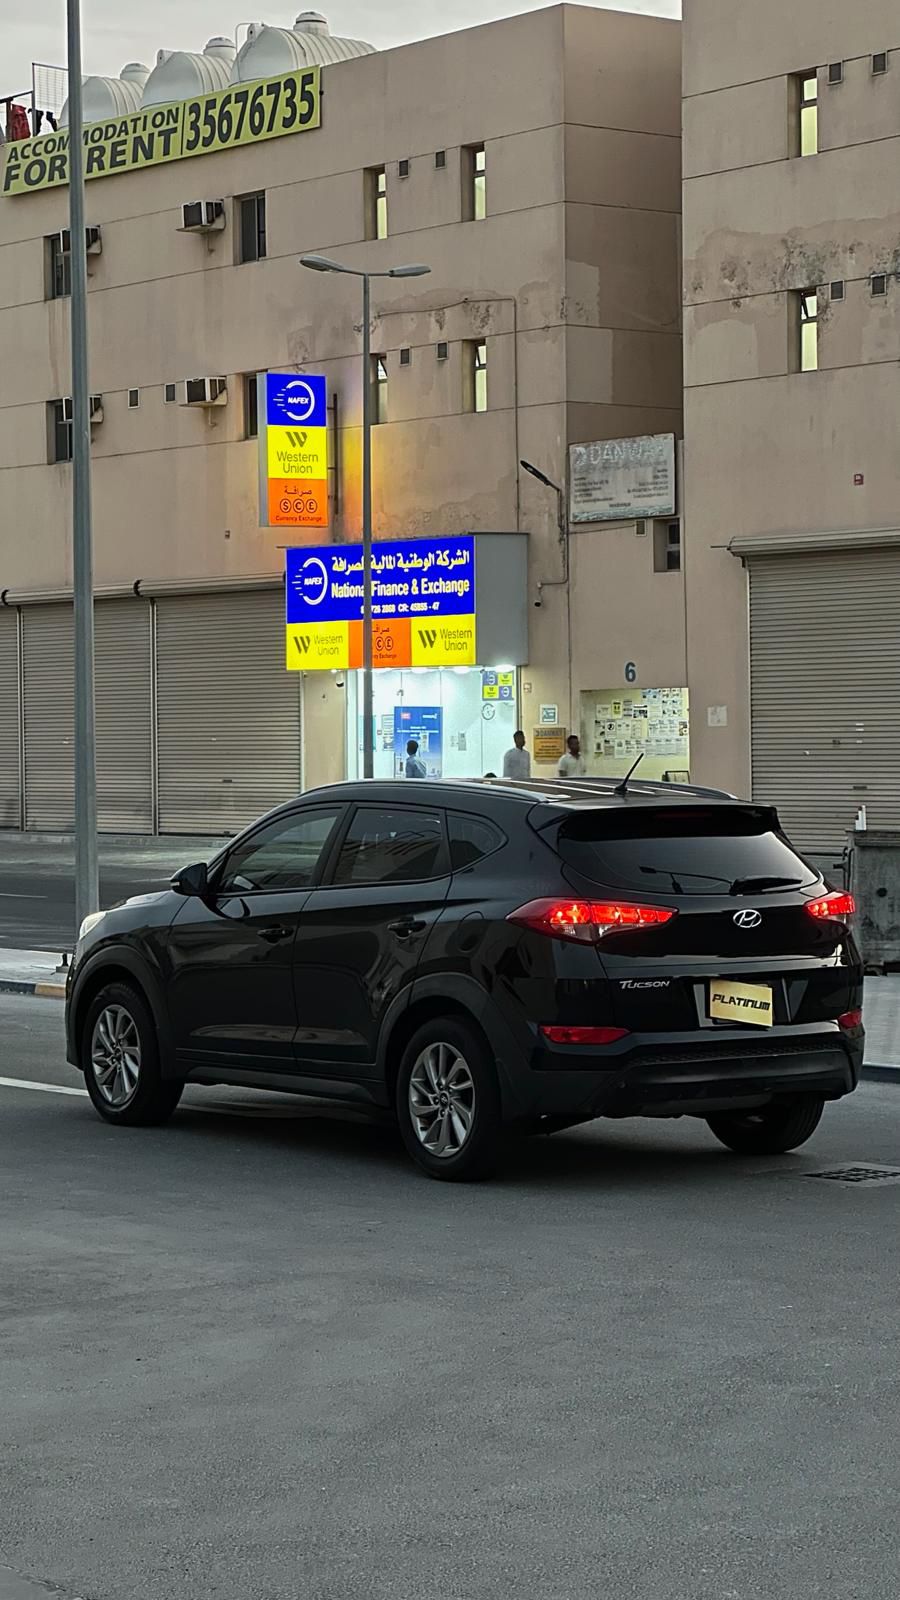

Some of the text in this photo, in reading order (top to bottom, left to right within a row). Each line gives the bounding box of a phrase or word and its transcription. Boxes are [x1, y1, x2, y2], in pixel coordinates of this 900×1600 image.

[186, 72, 315, 151] 35676735
[3, 127, 178, 192] FOR RENT
[287, 396, 309, 405] NAFEX
[277, 451, 319, 462] Western
[282, 463, 313, 474] Union
[331, 549, 470, 576] الشركة الوطنية المالية لصرافة
[304, 577, 323, 586] NAFEX
[331, 577, 470, 599] Nationa Finance & Exchange
[372, 624, 390, 635] صراف
[440, 628, 473, 640] Western
[314, 634, 344, 646] Western
[445, 639, 468, 651] Union
[318, 646, 340, 656] Union
[625, 661, 636, 683] 6
[712, 993, 771, 1011] PLATINUM
